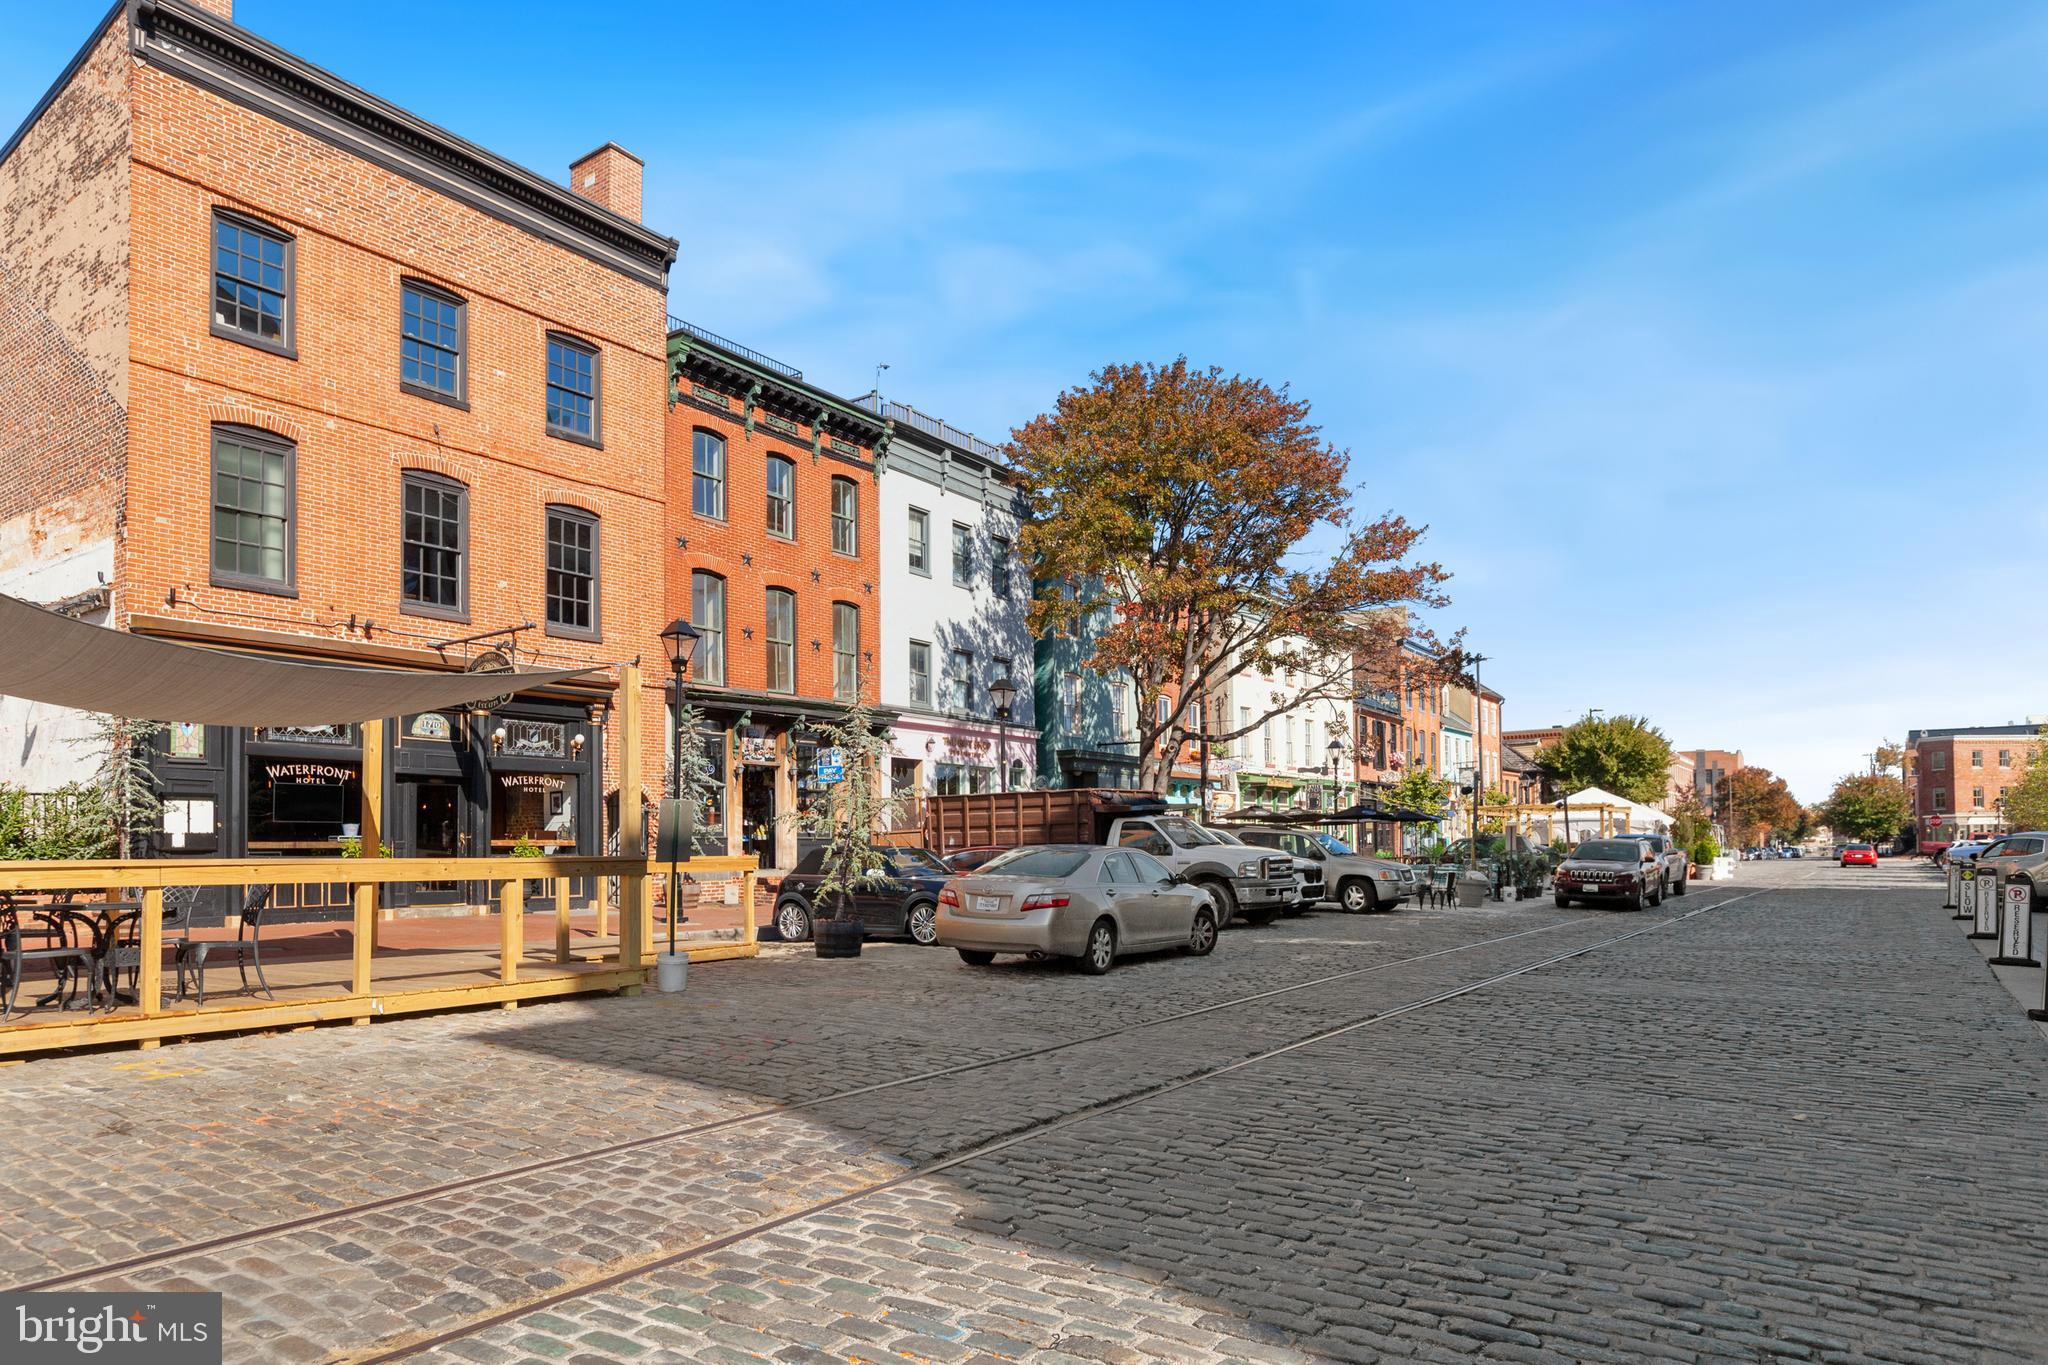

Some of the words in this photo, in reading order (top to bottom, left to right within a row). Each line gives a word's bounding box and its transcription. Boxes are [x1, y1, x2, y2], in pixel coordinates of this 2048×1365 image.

[265, 764, 351, 780] WATERFRONT
[501, 776, 566, 789] WATERFRONT
[1963, 882, 1972, 913] SLOW
[2012, 904, 2021, 955] RESERVED
